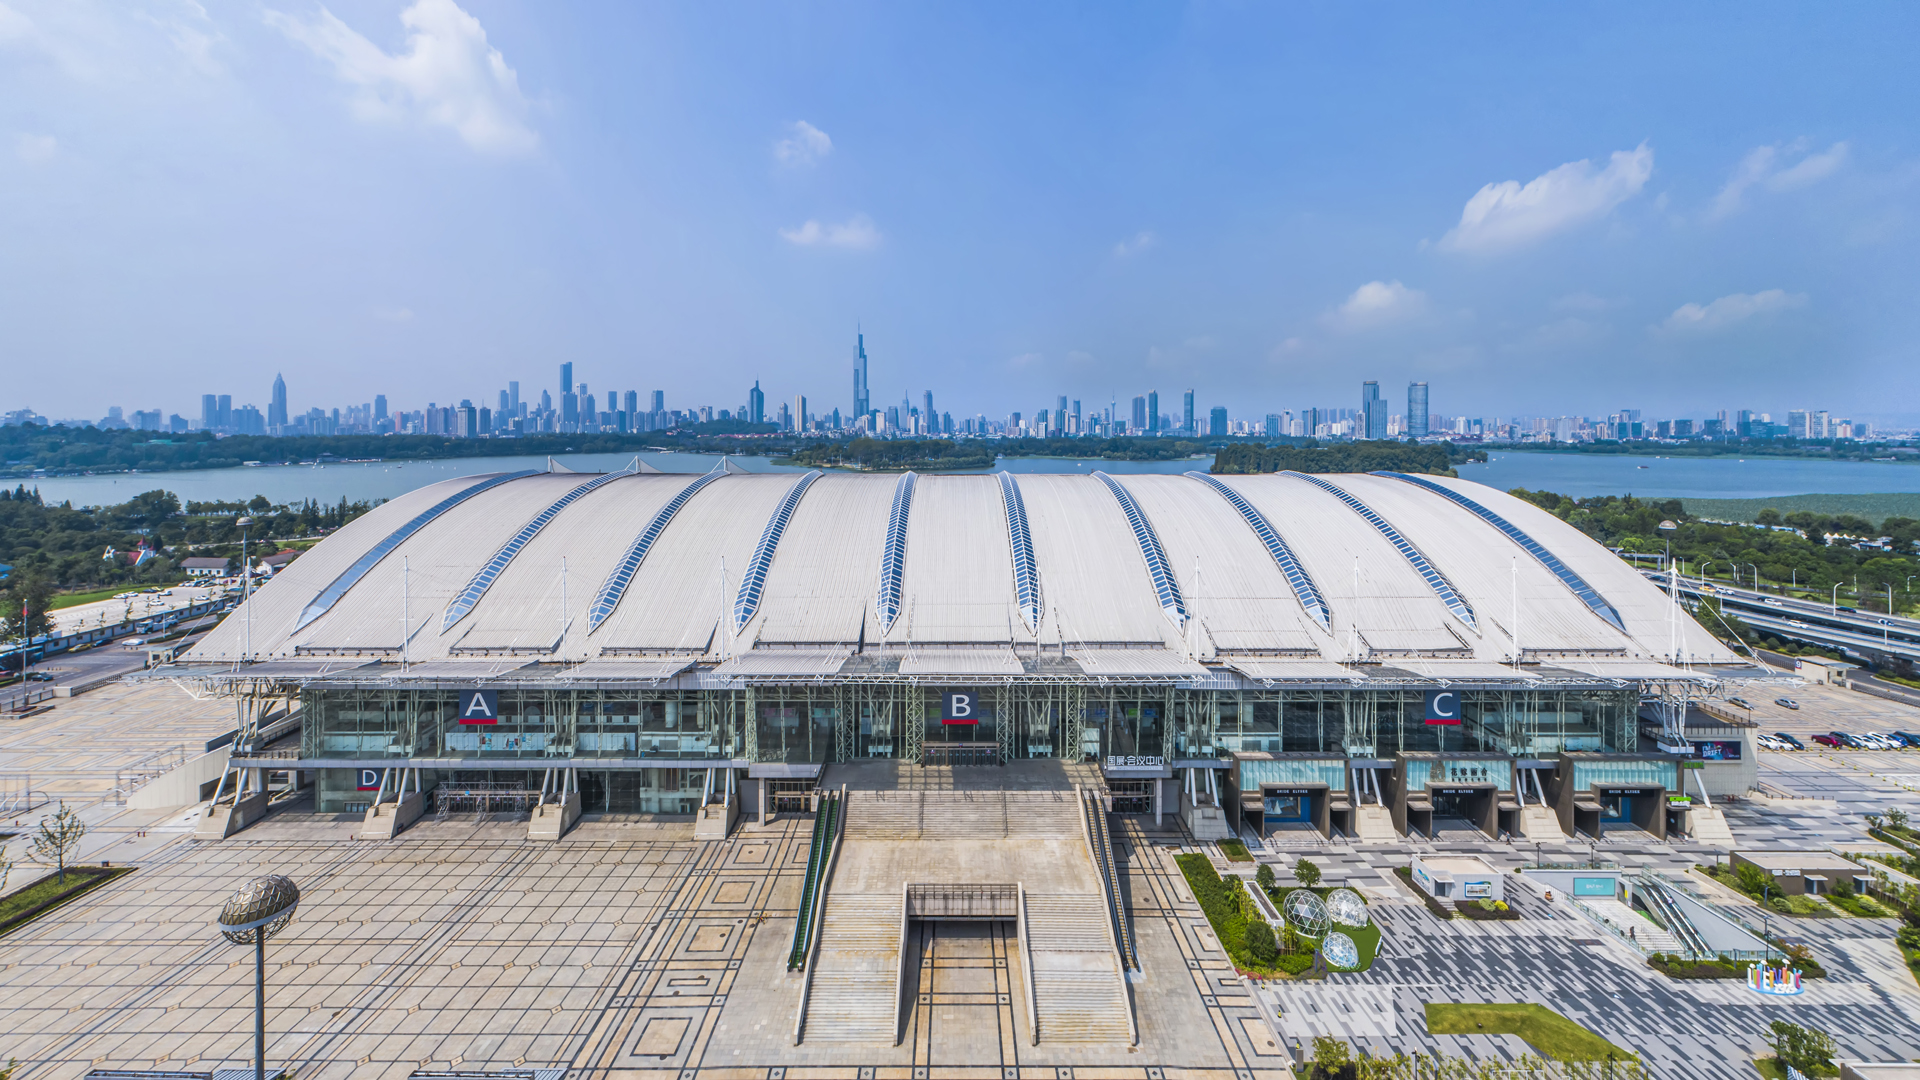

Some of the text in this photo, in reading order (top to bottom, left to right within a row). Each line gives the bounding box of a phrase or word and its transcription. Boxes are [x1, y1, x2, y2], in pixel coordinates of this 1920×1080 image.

[464, 692, 492, 717] A
[951, 694, 971, 717] B
[1433, 692, 1454, 717] C
[362, 769, 378, 786] D
